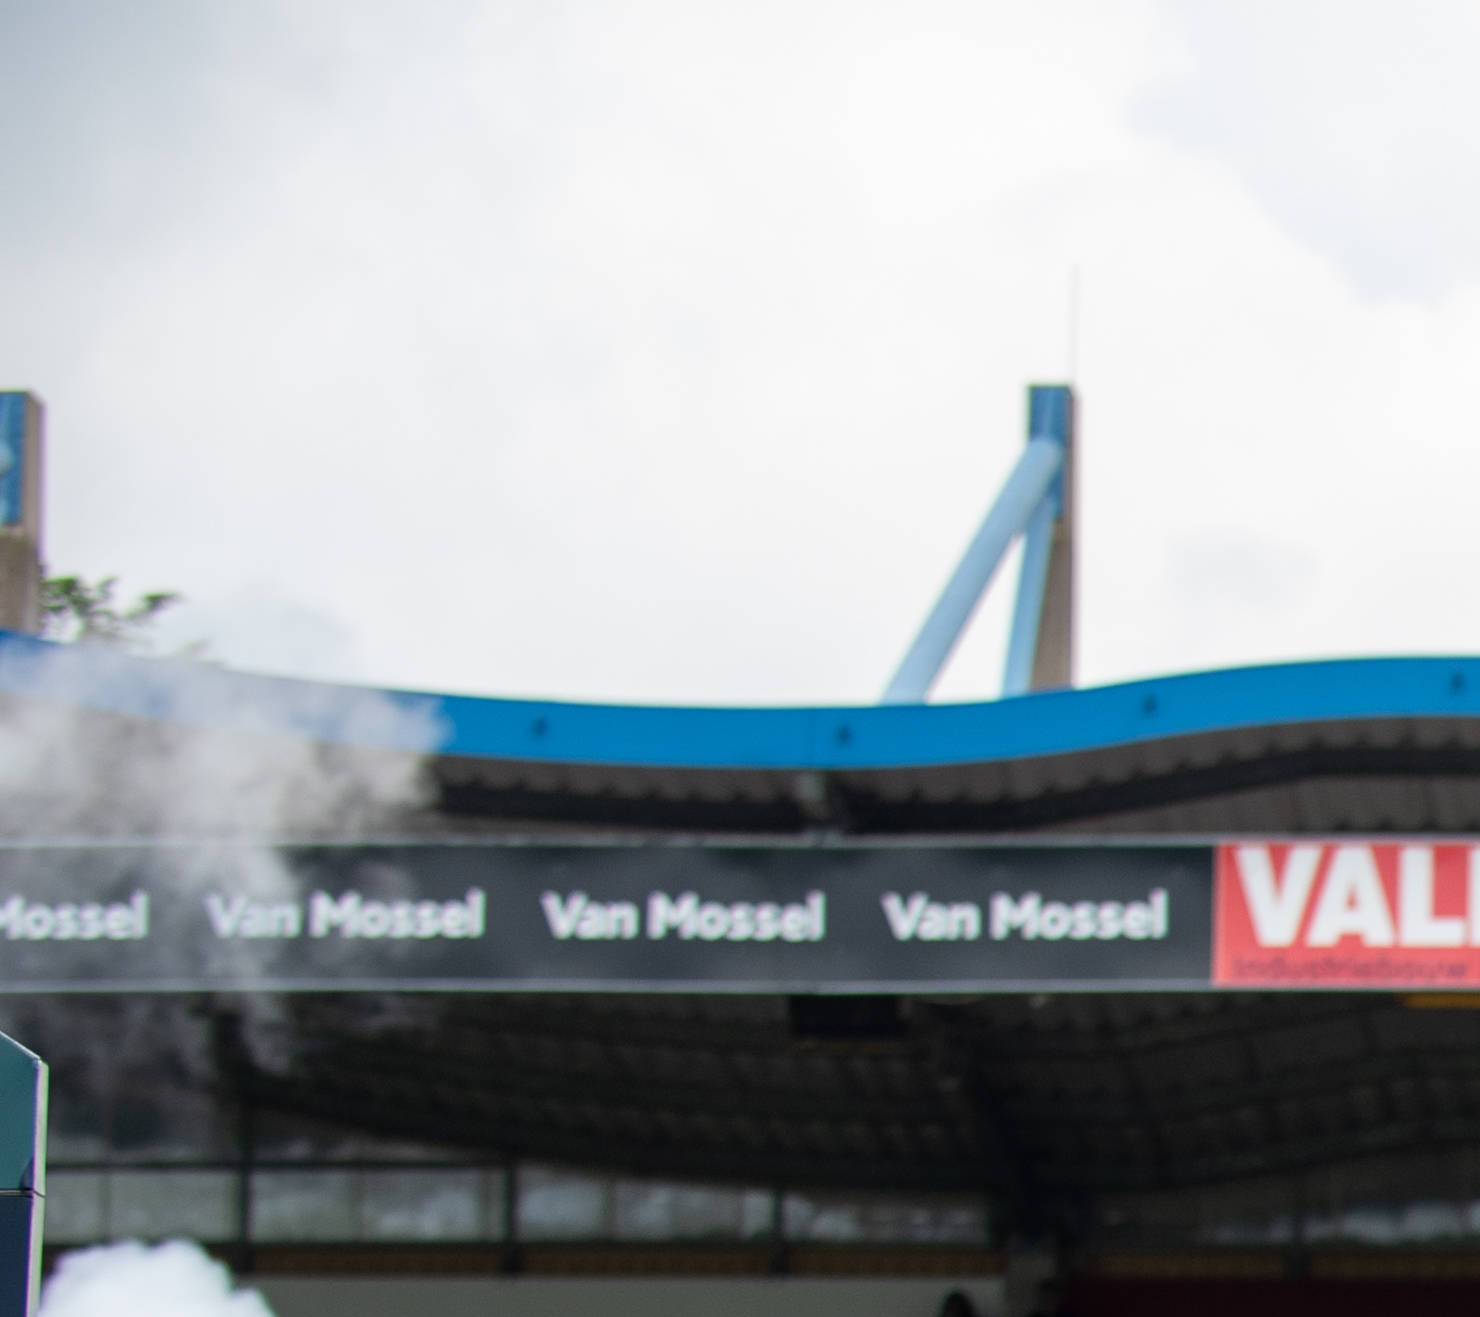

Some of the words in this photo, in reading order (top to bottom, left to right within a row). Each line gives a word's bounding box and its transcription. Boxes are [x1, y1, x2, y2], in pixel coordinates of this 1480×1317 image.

[204, 893, 299, 939] Van
[309, 887, 486, 938] Mossel
[540, 890, 639, 940] Van
[647, 890, 826, 941] Mossel
[882, 891, 981, 941] Van
[989, 888, 1168, 940] Mossel
